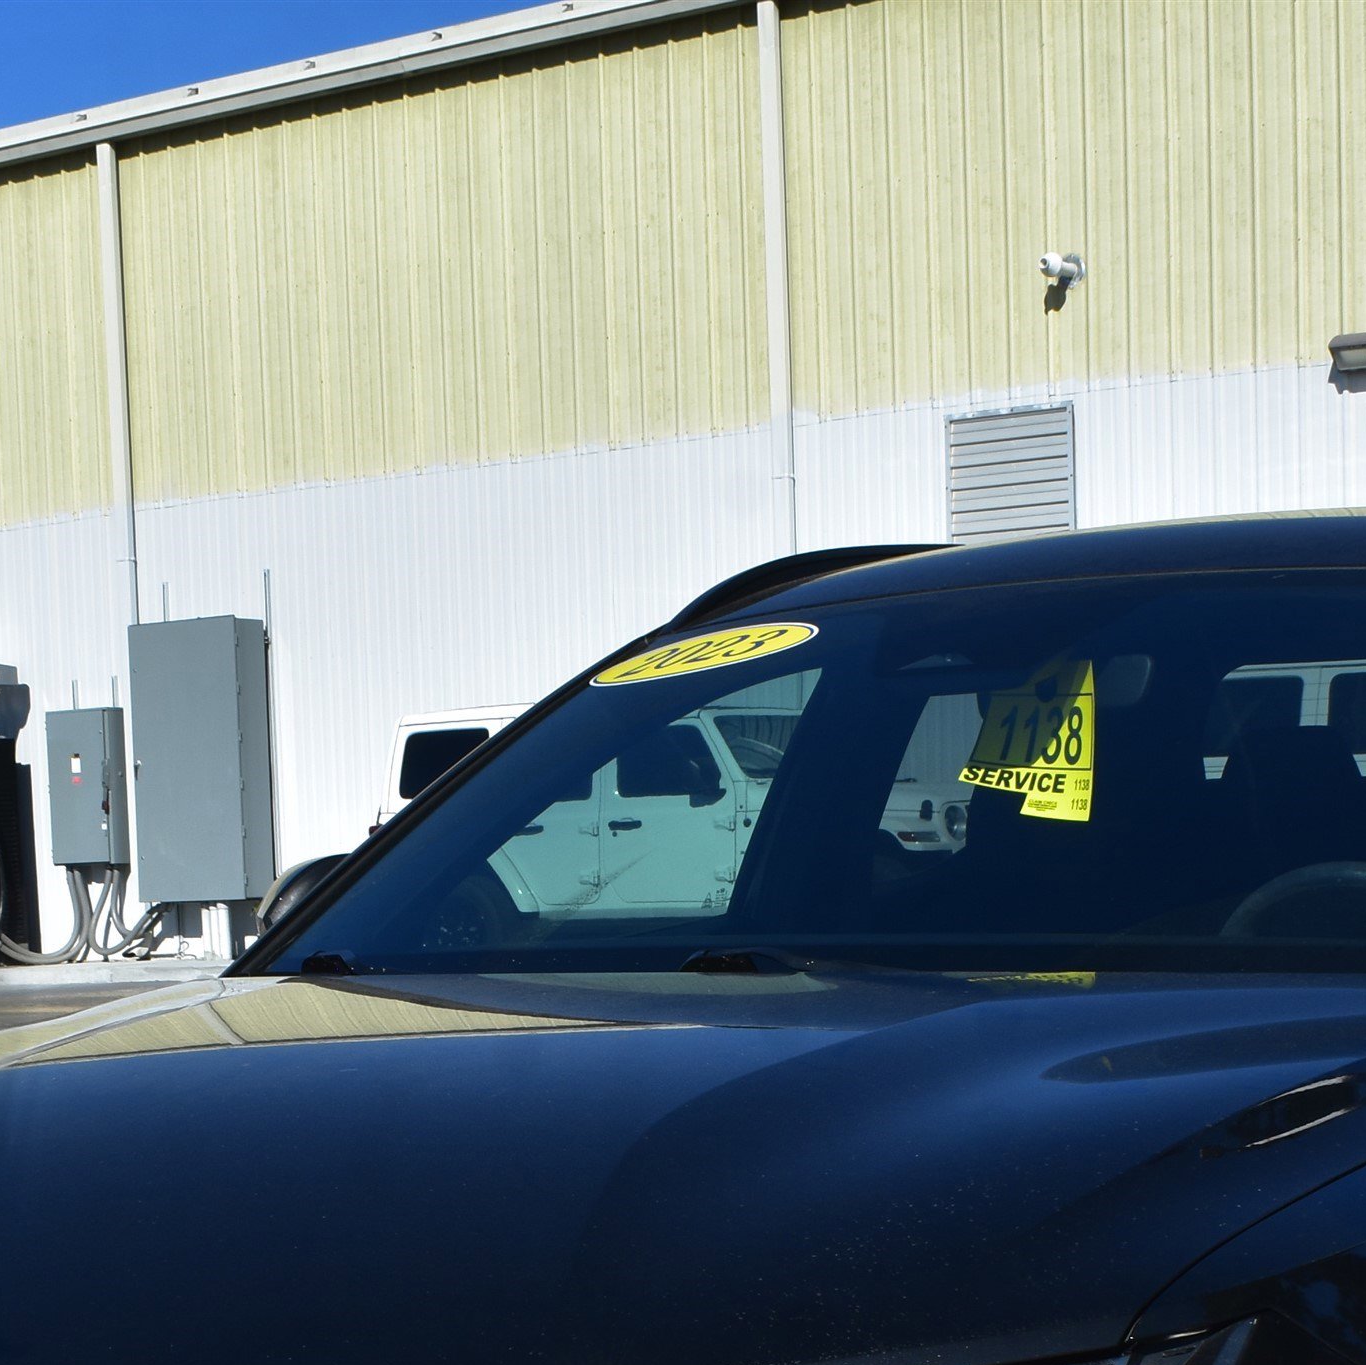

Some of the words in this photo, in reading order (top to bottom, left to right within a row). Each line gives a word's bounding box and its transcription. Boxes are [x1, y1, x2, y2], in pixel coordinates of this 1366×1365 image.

[614, 629, 789, 680] 2023
[1000, 706, 1083, 765] 1138
[963, 766, 1067, 793] SERVICE
[1074, 779, 1090, 791] 1138
[1071, 799, 1088, 810] 1138
